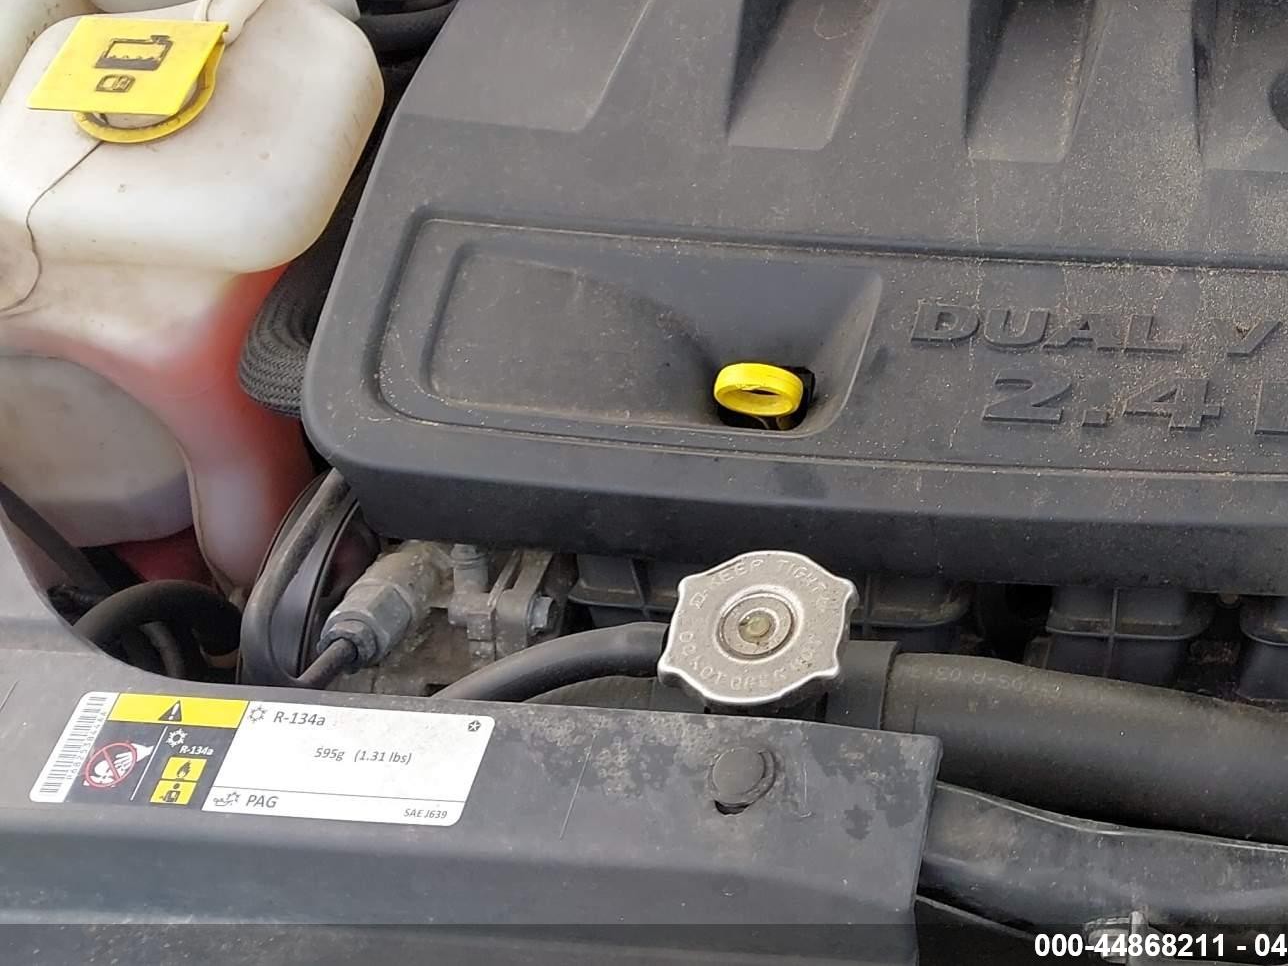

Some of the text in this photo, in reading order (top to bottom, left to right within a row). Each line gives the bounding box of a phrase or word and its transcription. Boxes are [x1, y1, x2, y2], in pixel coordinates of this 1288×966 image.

[909, 299, 1186, 354] DUAL
[709, 558, 828, 593] KEEP TIGHT
[273, 710, 326, 727] R-134a
[178, 745, 215, 756] R-134a
[313, 747, 412, 765] 595g (1.31 lbs)
[246, 794, 280, 810] PAG
[403, 808, 448, 819] SAE J639
